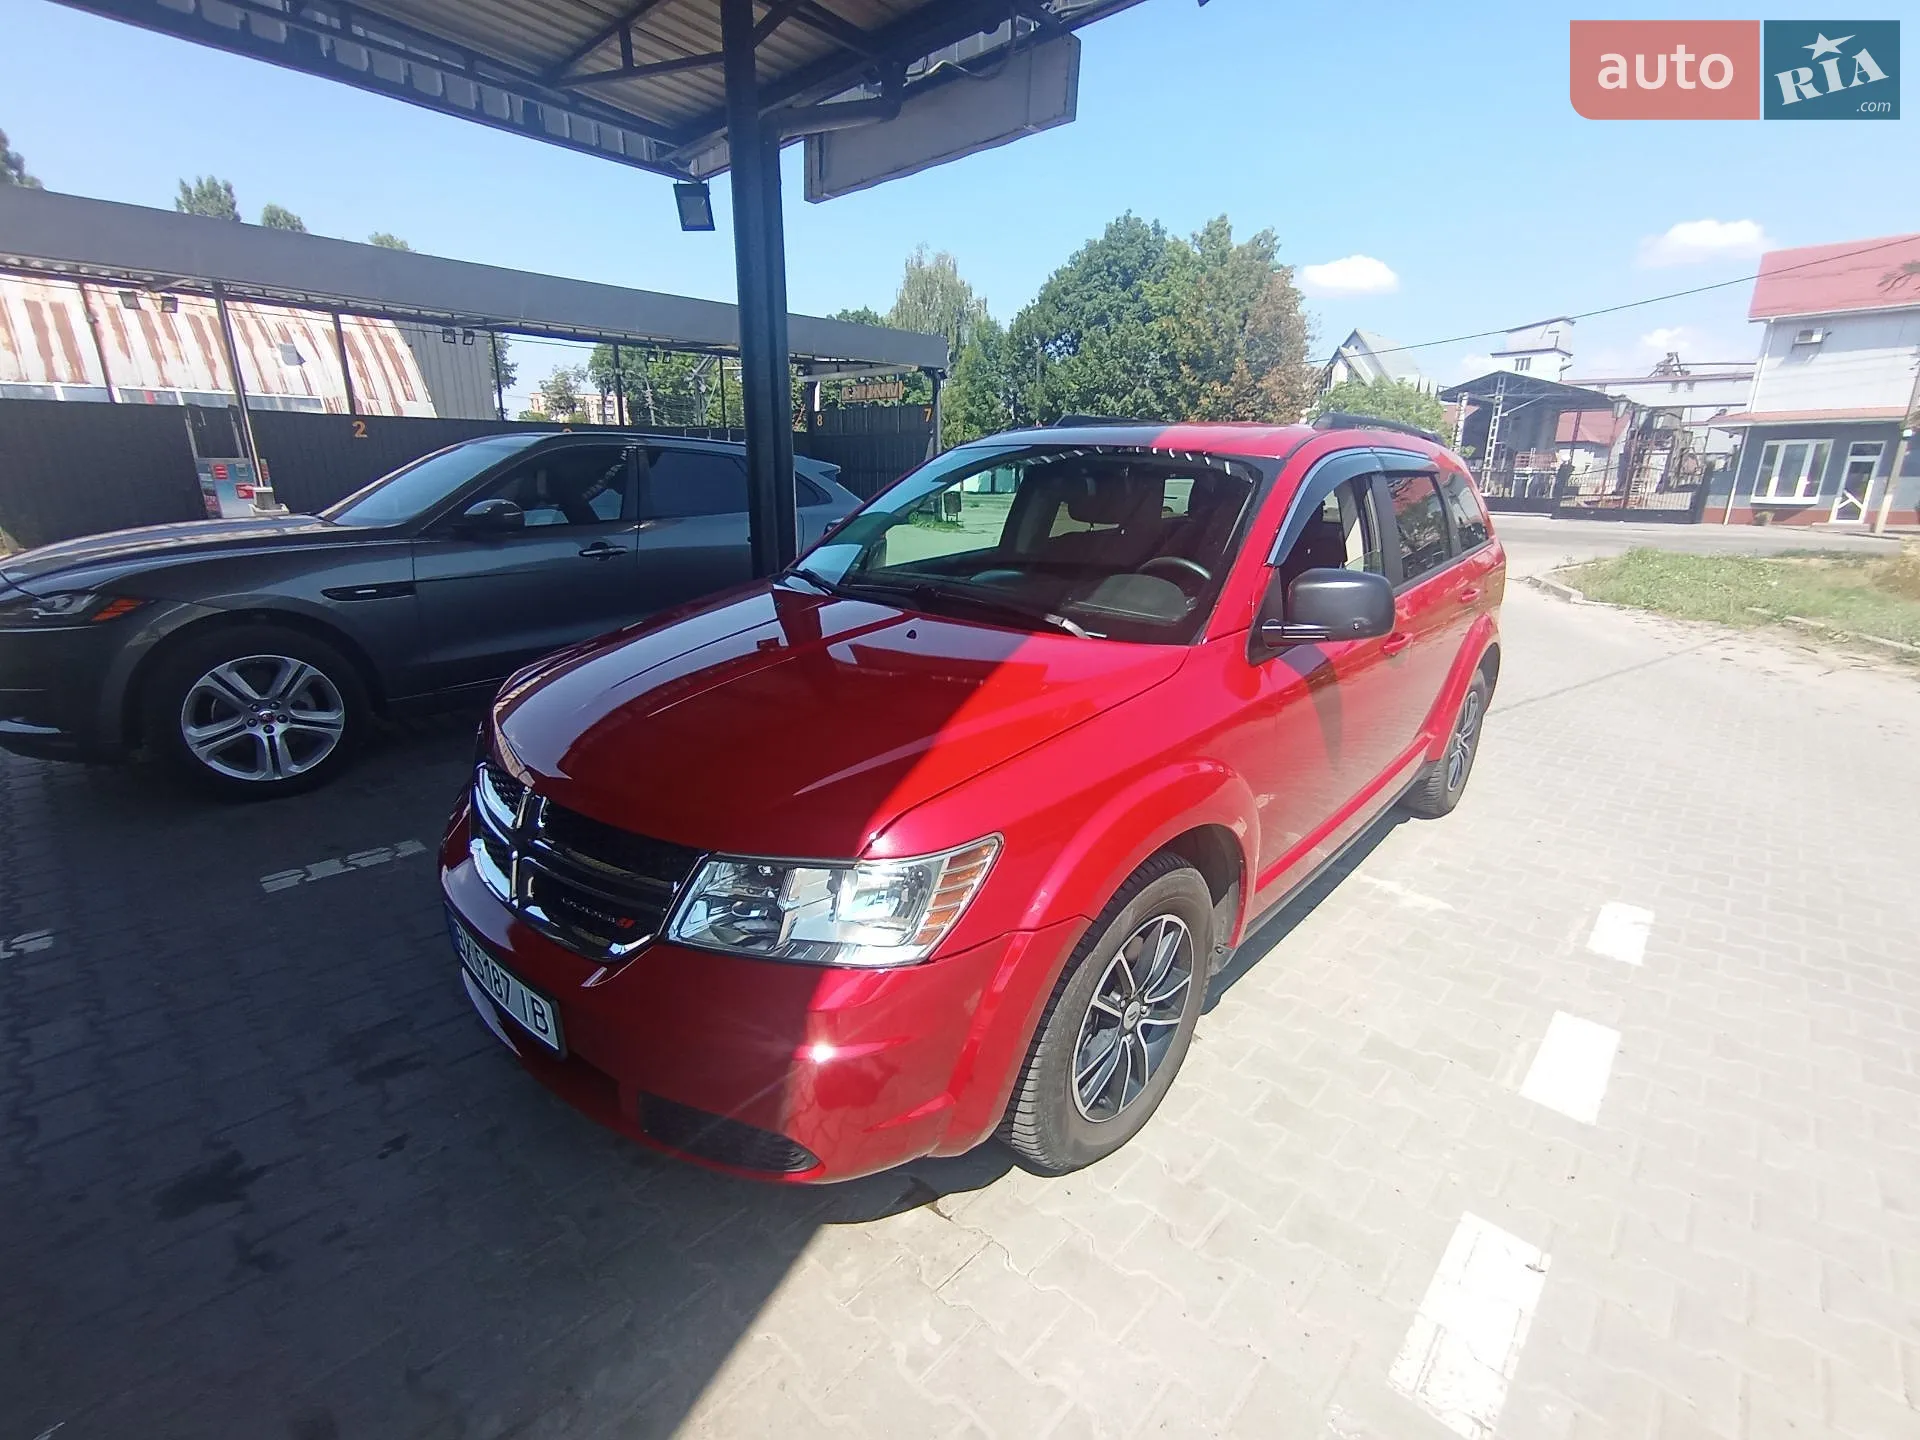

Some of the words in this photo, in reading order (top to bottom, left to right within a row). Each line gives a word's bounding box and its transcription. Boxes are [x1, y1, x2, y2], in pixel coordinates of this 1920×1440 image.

[817, 414, 823, 427] 8
[924, 406, 933, 422] 7
[352, 420, 368, 438] 2
[474, 947, 512, 1005] 5187
[520, 989, 550, 1035] IB
